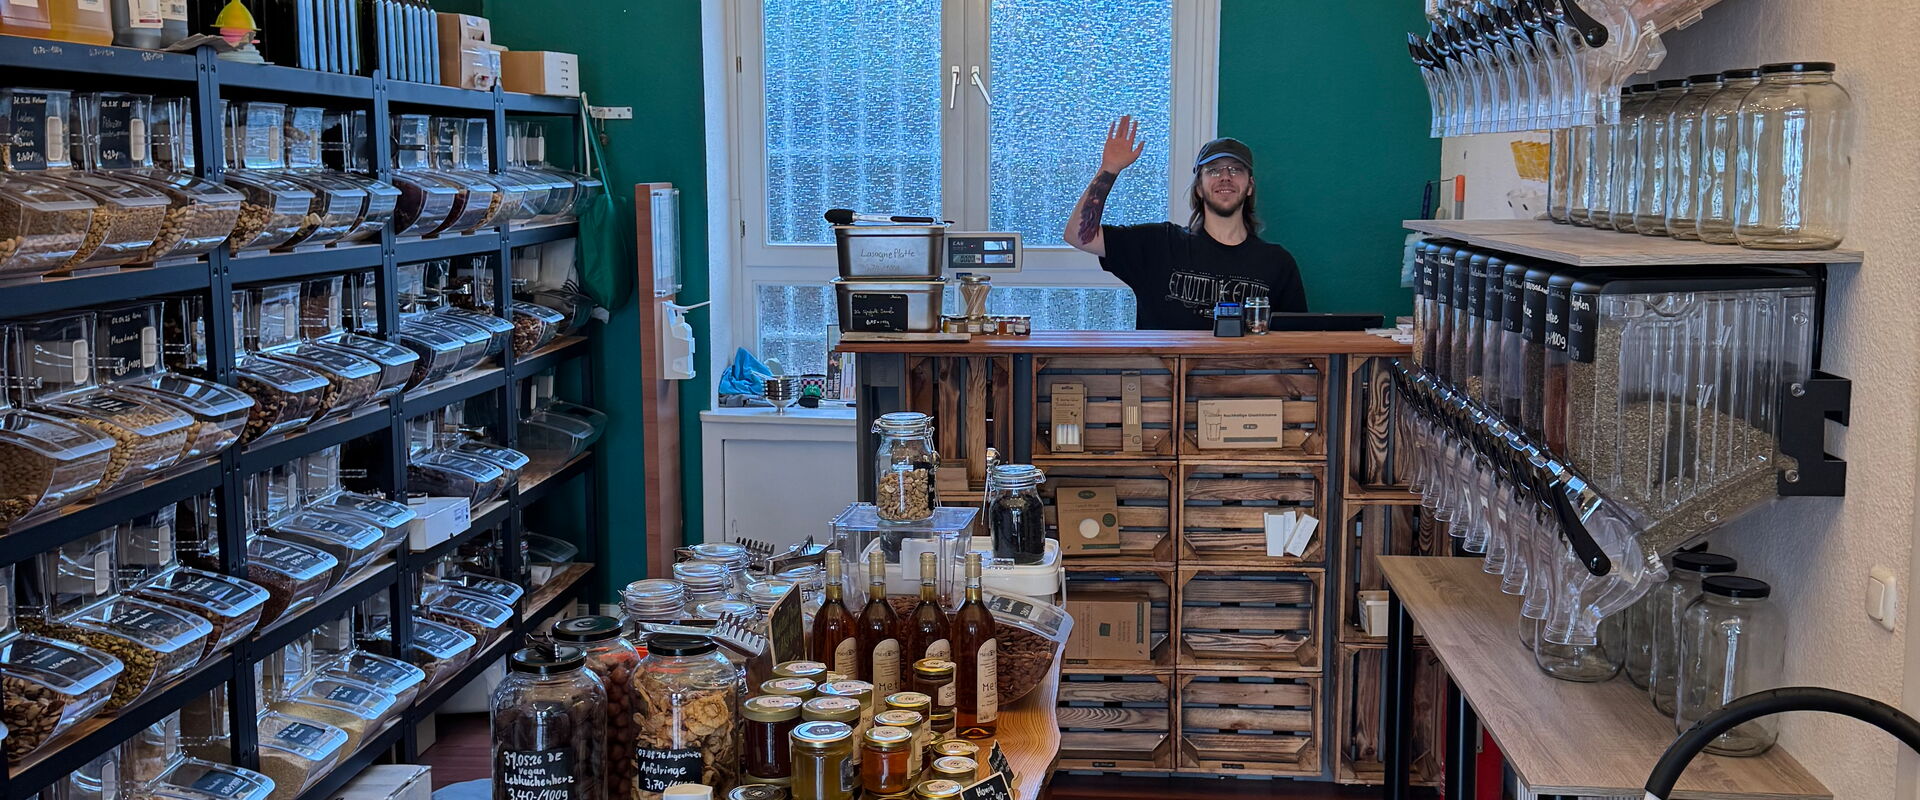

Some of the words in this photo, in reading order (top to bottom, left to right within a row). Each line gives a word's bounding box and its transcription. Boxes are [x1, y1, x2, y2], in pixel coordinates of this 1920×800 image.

[547, 752, 564, 763] DE
[640, 760, 687, 779] Apfelringe
[975, 783, 996, 798] Honig
